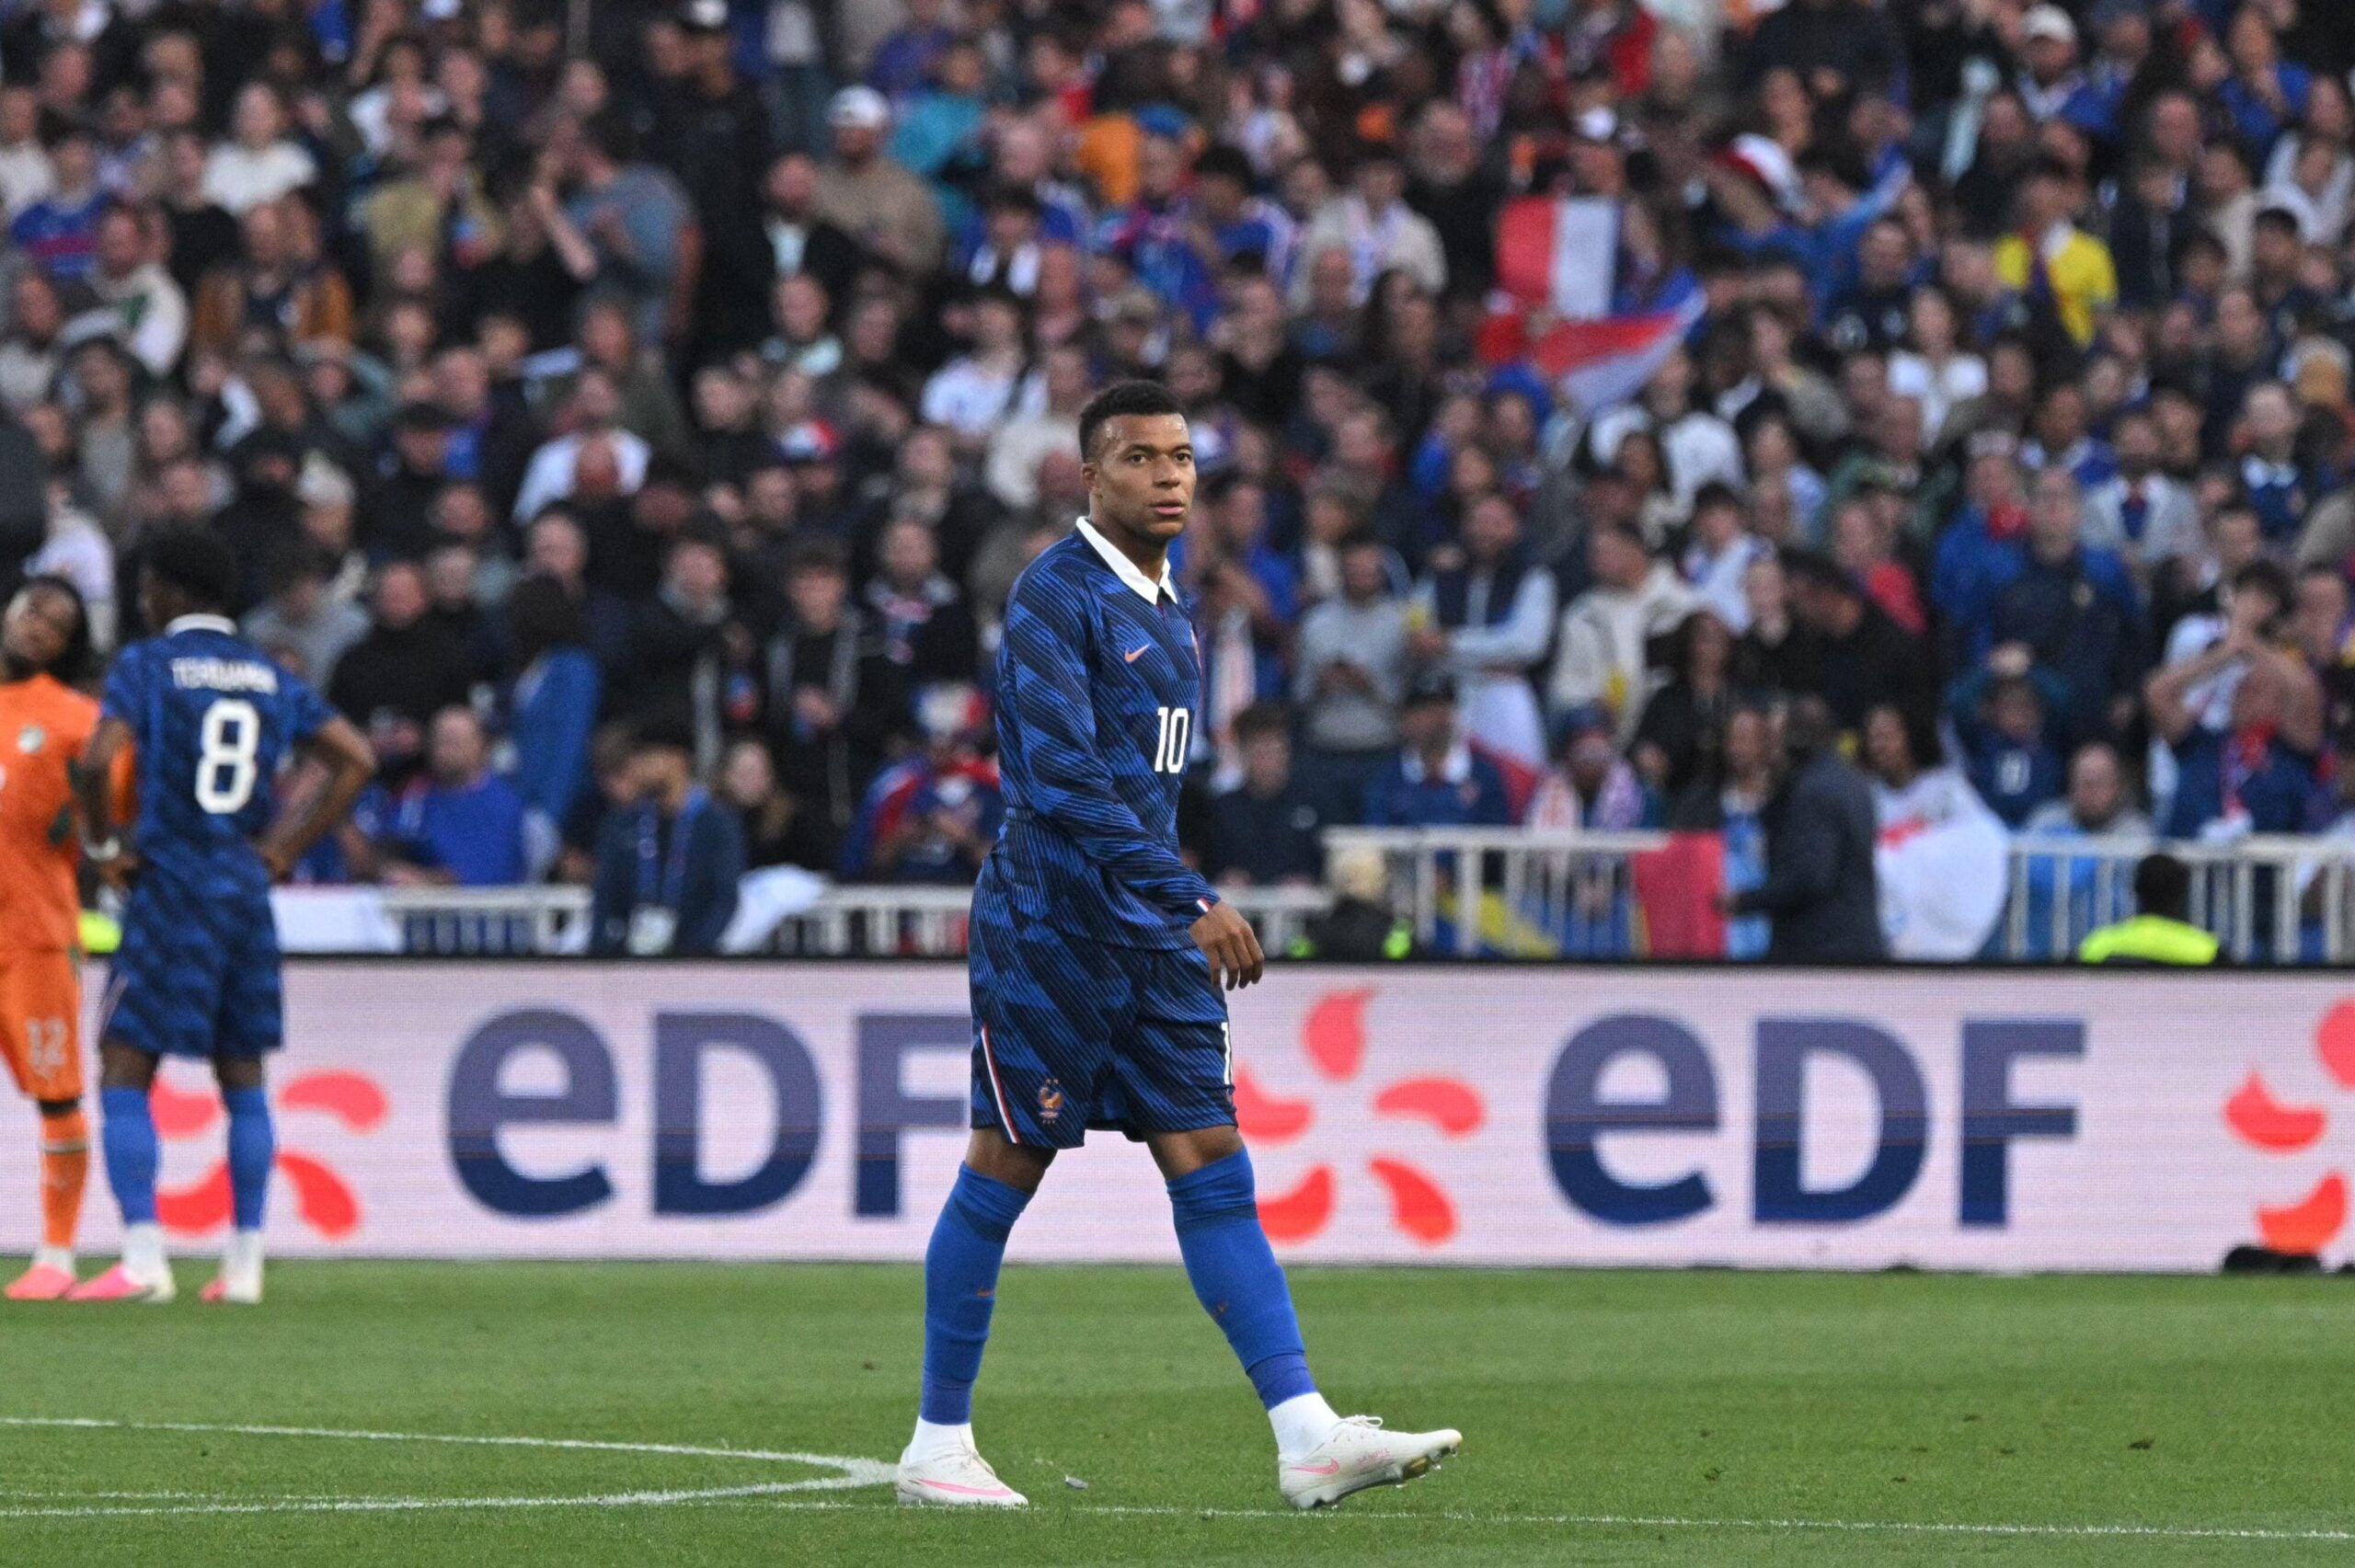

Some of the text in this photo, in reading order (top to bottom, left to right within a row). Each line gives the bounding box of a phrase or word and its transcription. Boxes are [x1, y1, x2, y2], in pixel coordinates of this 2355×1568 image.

[195, 699, 260, 814] 8
[1155, 706, 1189, 773] 10
[27, 1017, 69, 1066] 12
[1221, 1022, 1232, 1085] 1
